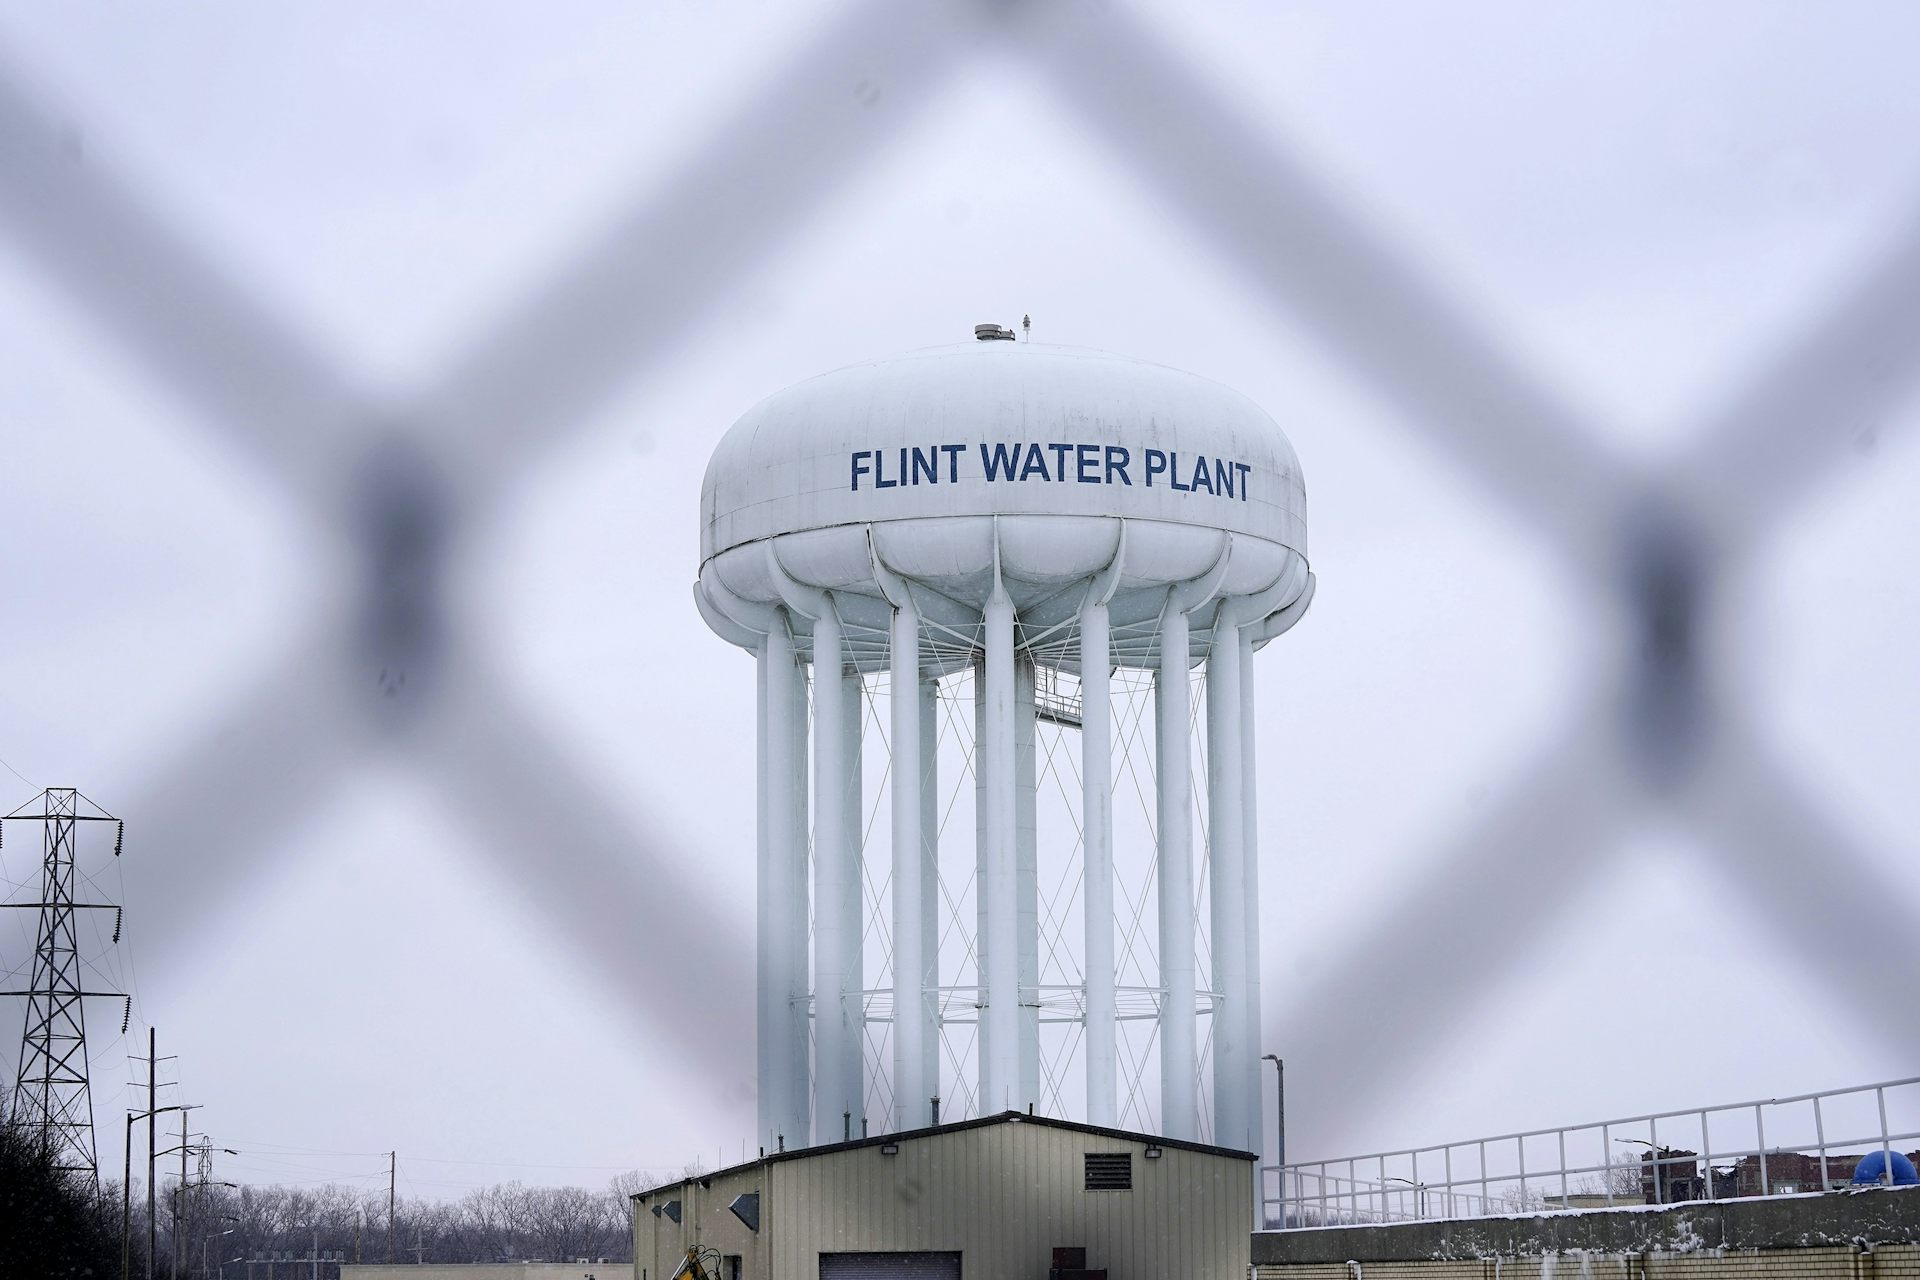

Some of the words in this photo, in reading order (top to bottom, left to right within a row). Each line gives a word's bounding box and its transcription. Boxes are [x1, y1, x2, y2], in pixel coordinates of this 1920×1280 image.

[851, 444, 967, 492] FLINT
[979, 442, 1133, 487] WATER
[1145, 448, 1251, 501] PLANT
